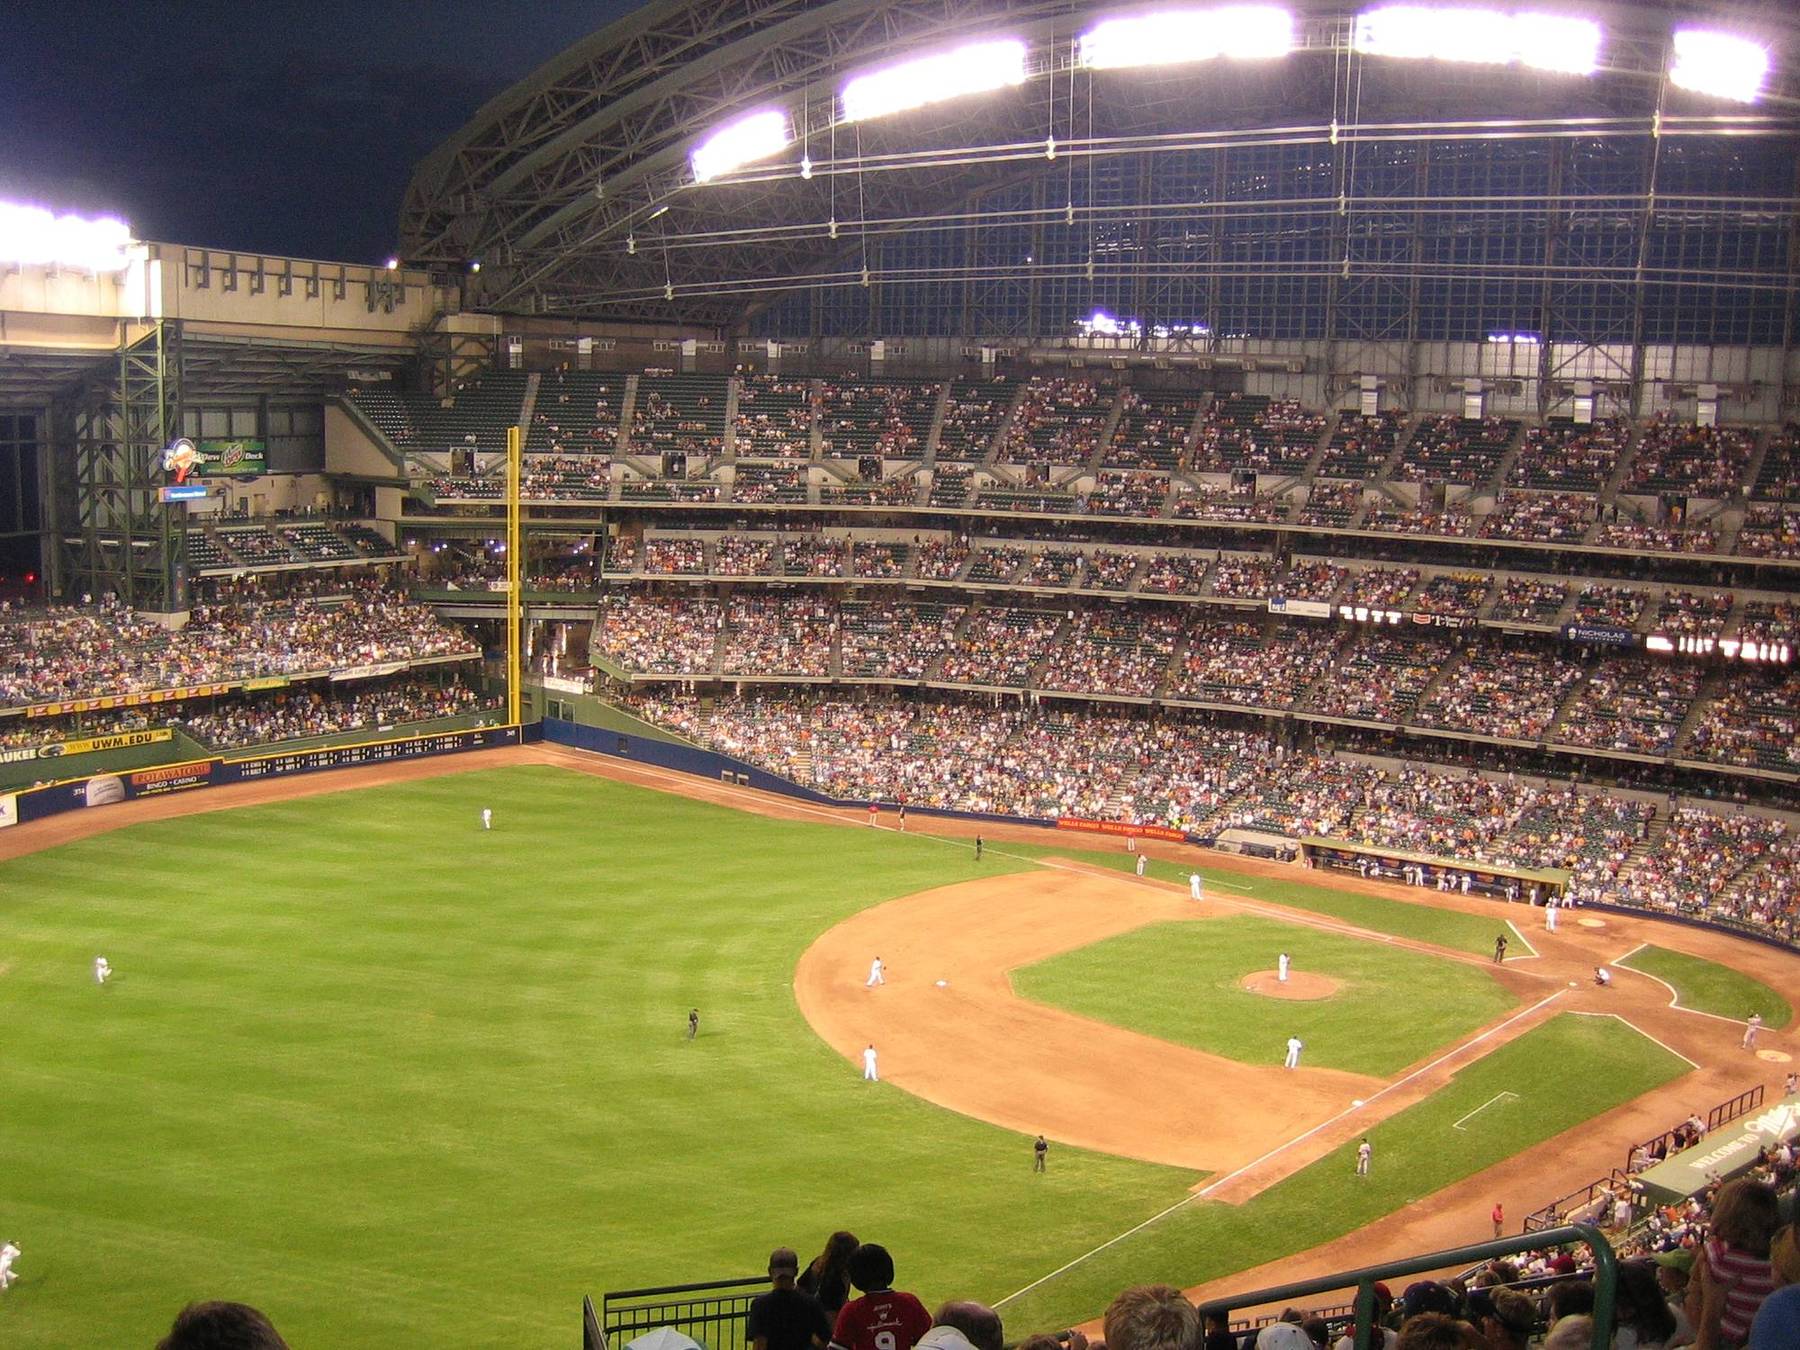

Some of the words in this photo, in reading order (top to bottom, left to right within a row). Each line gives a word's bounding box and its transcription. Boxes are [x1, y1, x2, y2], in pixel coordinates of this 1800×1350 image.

[1578, 629, 1625, 639] NICHOLAS
[92, 733, 153, 749] UWM.EDU
[137, 765, 206, 782] POTAWATOMI
[147, 781, 167, 790] BINGO
[1689, 1140, 1746, 1168] WELCOME
[1737, 1133, 1760, 1144] TO
